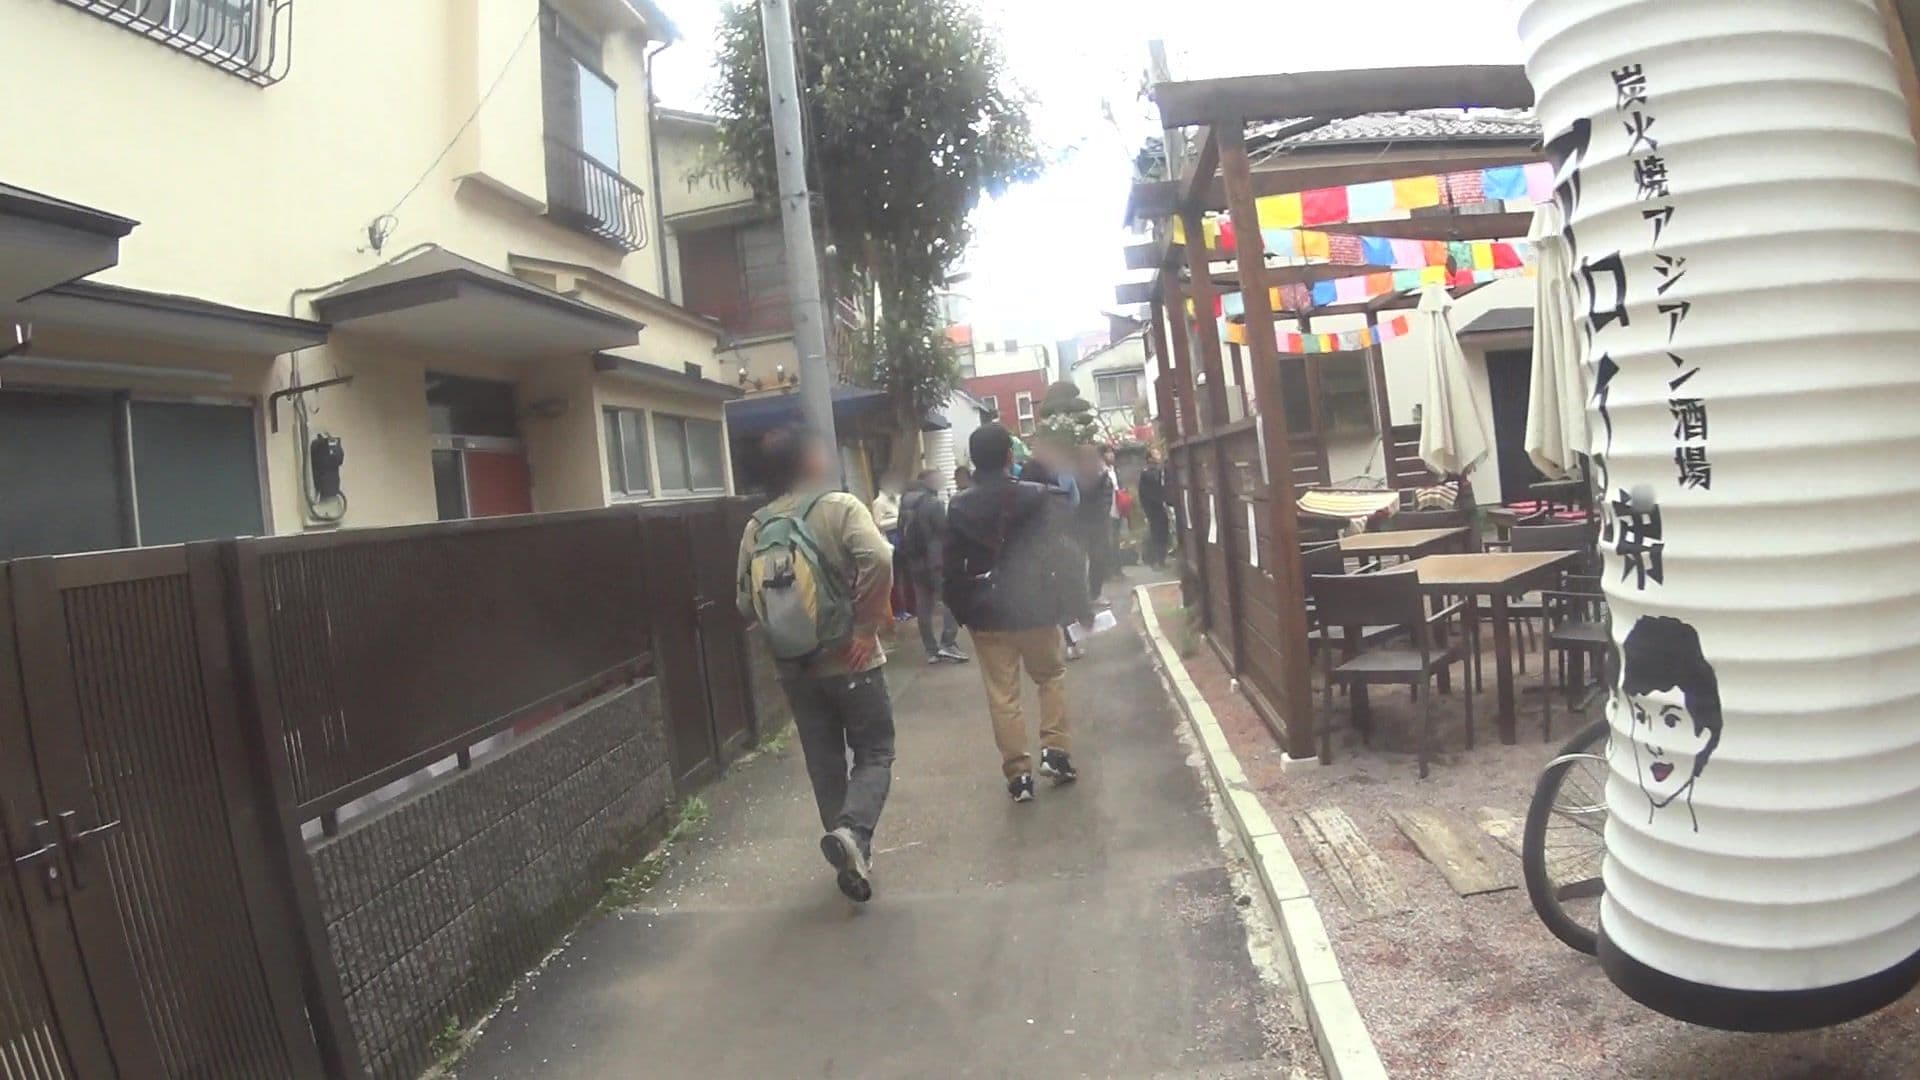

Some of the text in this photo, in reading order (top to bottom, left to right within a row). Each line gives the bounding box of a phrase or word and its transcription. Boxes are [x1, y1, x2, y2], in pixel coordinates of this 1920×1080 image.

[1611, 63, 1712, 490] 炭火焼アジアン酒場
